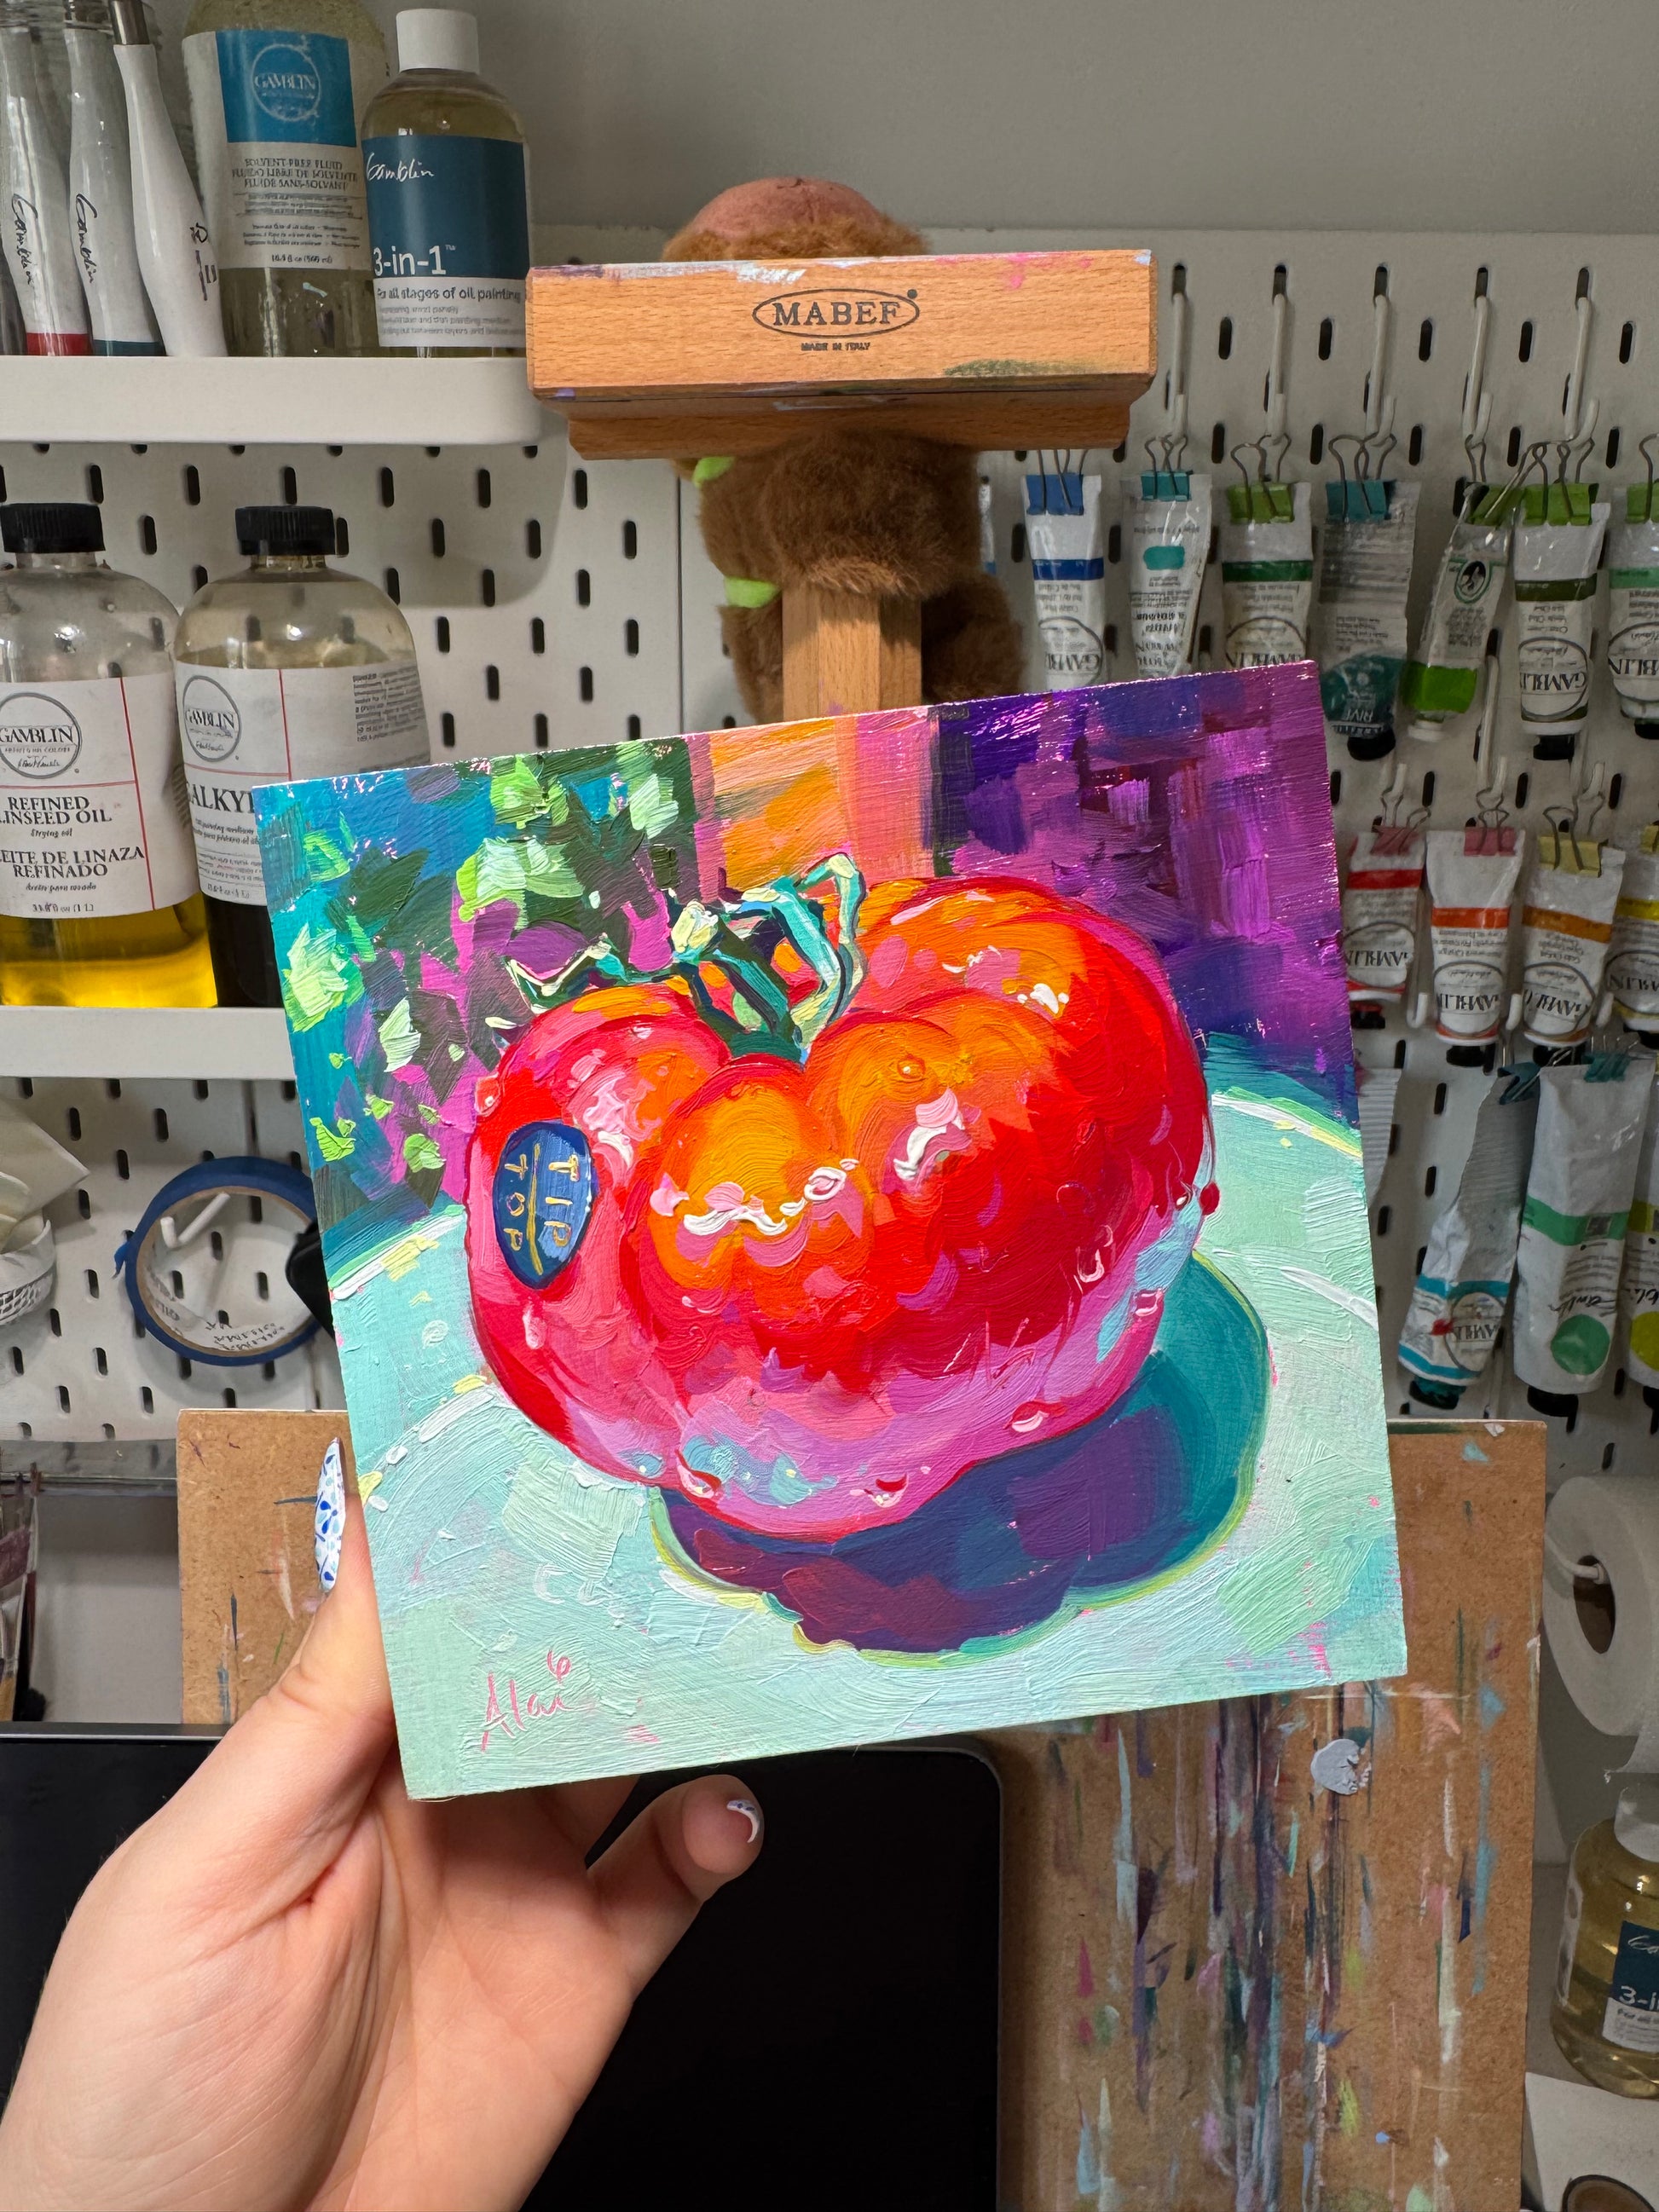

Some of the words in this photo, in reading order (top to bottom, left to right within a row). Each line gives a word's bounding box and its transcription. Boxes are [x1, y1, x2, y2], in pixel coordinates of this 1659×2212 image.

[367, 153, 434, 182] Gamblin
[76, 193, 98, 284] Gamblin
[442, 286, 456, 299] of
[459, 286, 476, 299] oil
[772, 301, 901, 326] MABEF
[832, 342, 842, 351] IN
[1608, 657, 1659, 677] BLIN
[185, 708, 235, 728] GAMBLIN
[0, 727, 74, 743] GAMBLIN
[8, 796, 90, 811] REFINED
[186, 782, 255, 814] ALKY
[75, 808, 113, 824] OIL
[42, 851, 69, 864] DE
[72, 846, 146, 864] LINAZA
[12, 863, 108, 879] REFINADO
[1345, 950, 1408, 968] AMBLI
[503, 1153, 529, 1251] TOP
[544, 1153, 581, 1248] TIP
